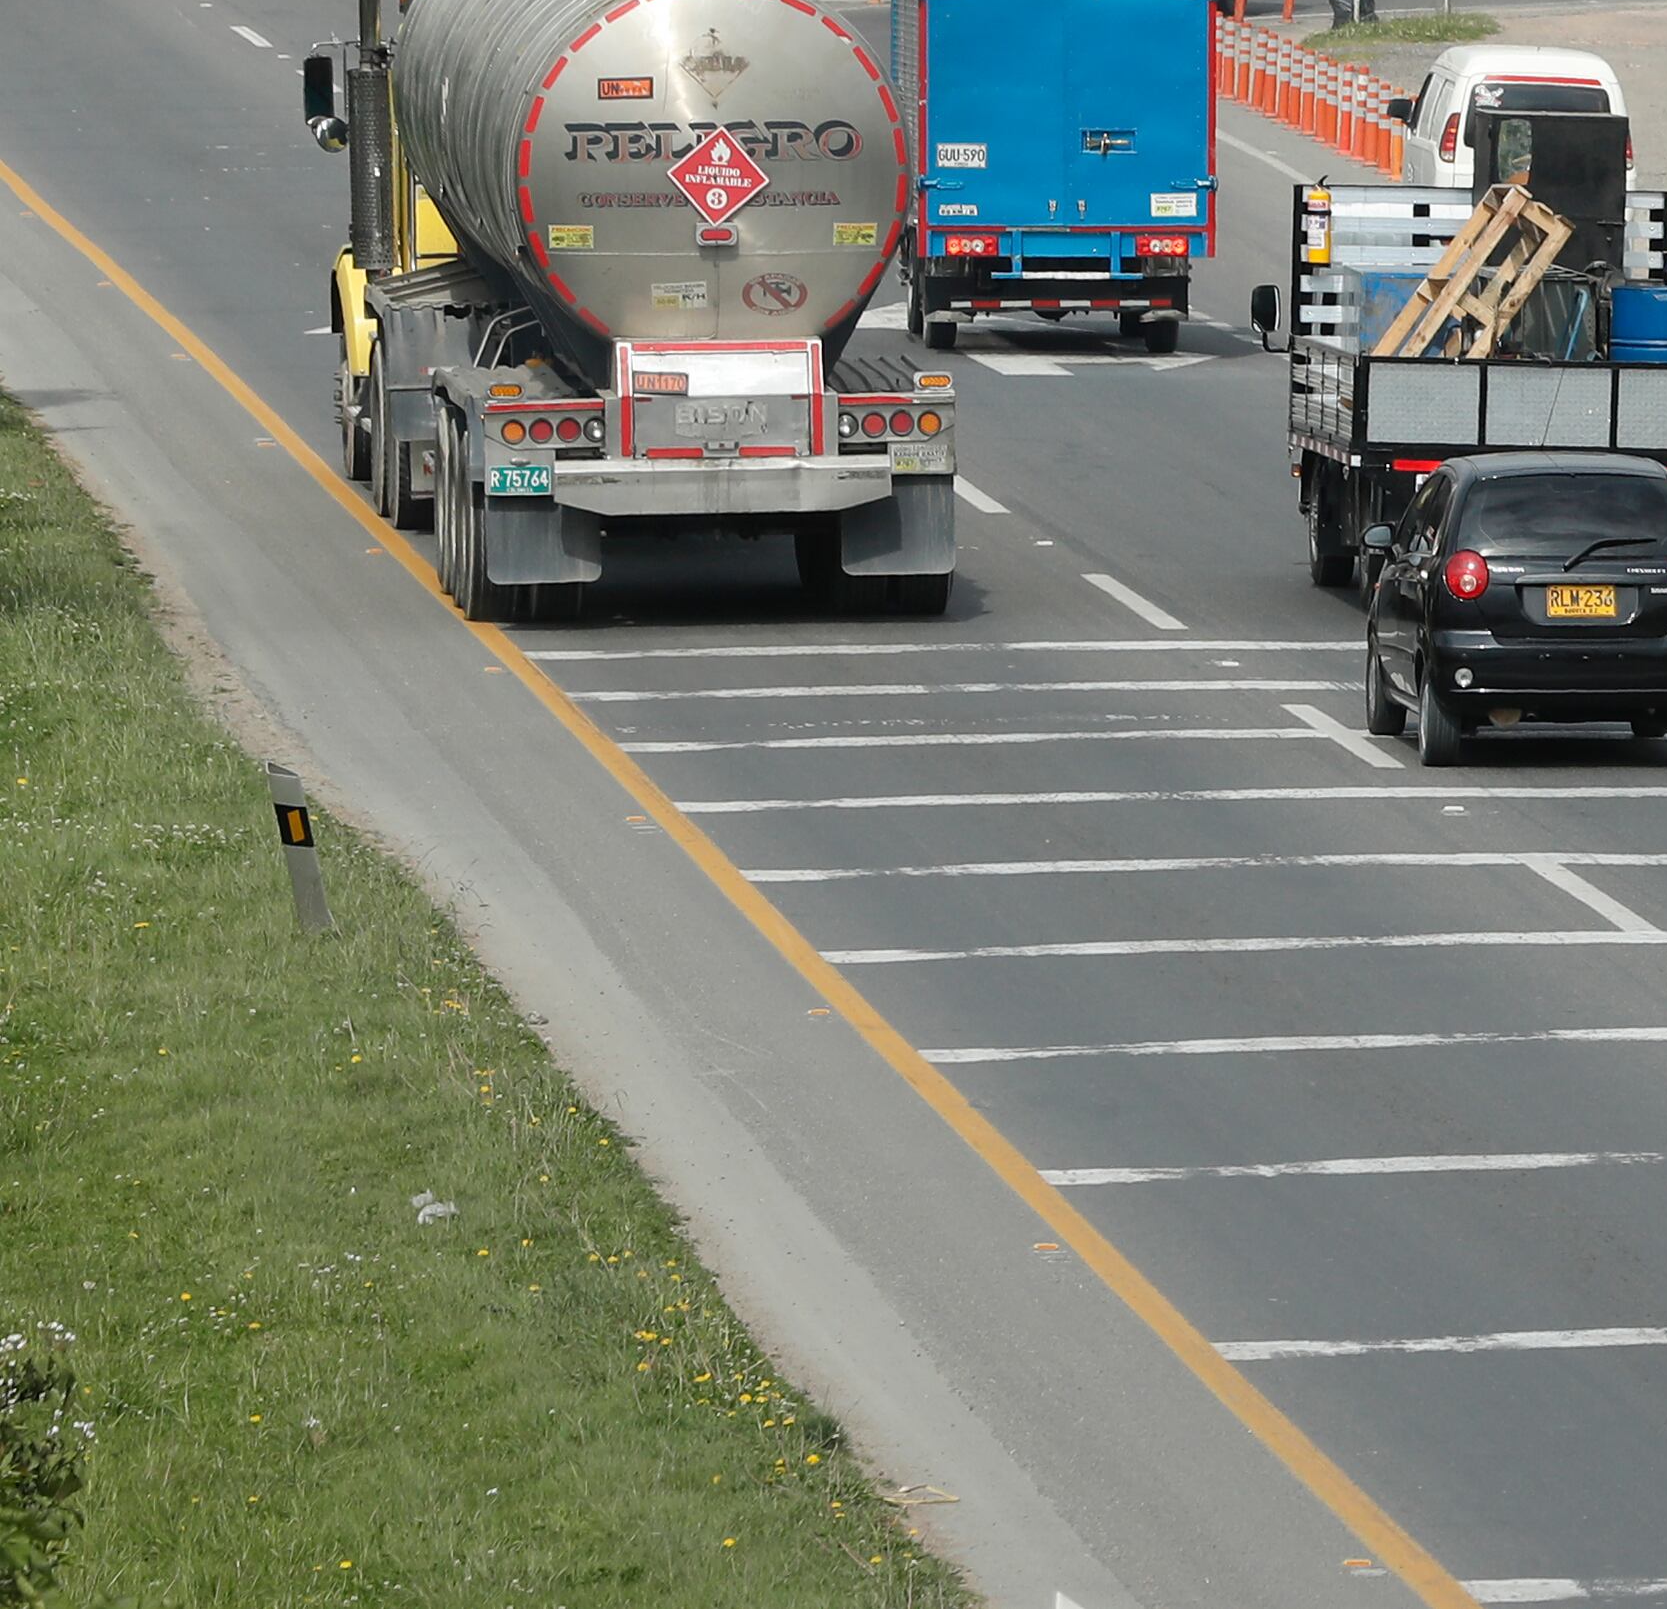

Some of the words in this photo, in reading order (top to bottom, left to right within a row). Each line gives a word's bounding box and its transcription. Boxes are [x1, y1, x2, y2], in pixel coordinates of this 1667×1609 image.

[697, 165, 741, 177] LIQUIDO
[684, 173, 752, 188] INFLAMABLE
[579, 192, 689, 208] CONSERVE
[749, 191, 841, 207] STANCIA
[710, 191, 723, 206] 3
